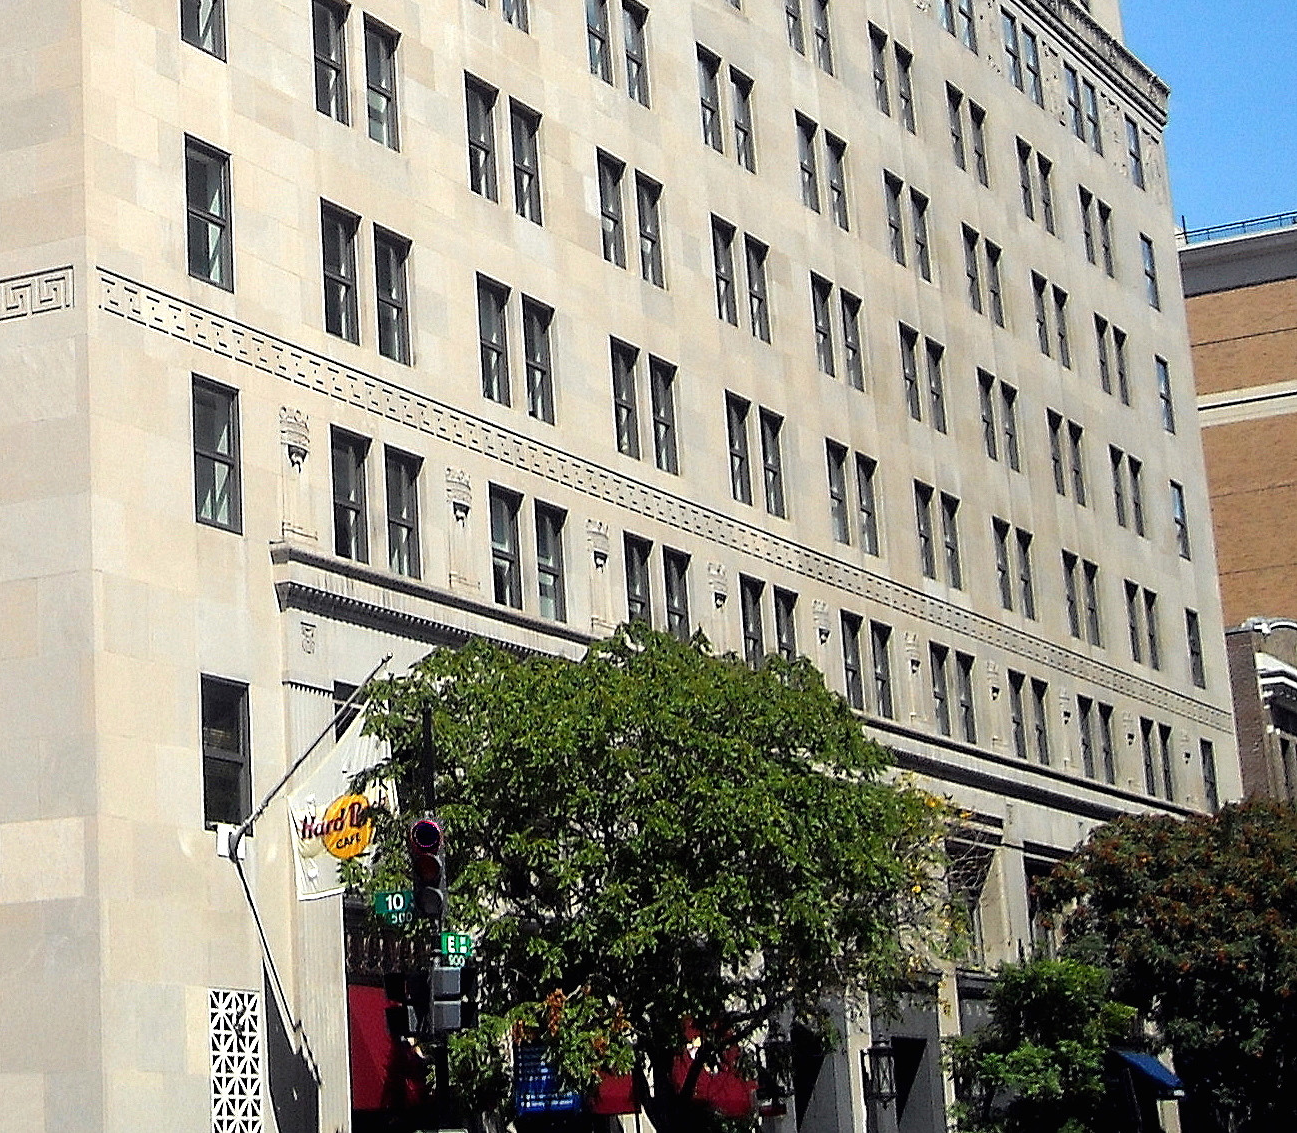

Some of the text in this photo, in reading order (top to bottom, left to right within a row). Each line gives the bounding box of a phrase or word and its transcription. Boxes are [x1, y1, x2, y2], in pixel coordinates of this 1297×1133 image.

[300, 807, 346, 841] Hard
[336, 832, 362, 850] CAFE
[385, 893, 404, 911] 10
[391, 911, 413, 924] 500
[447, 935, 455, 953] E
